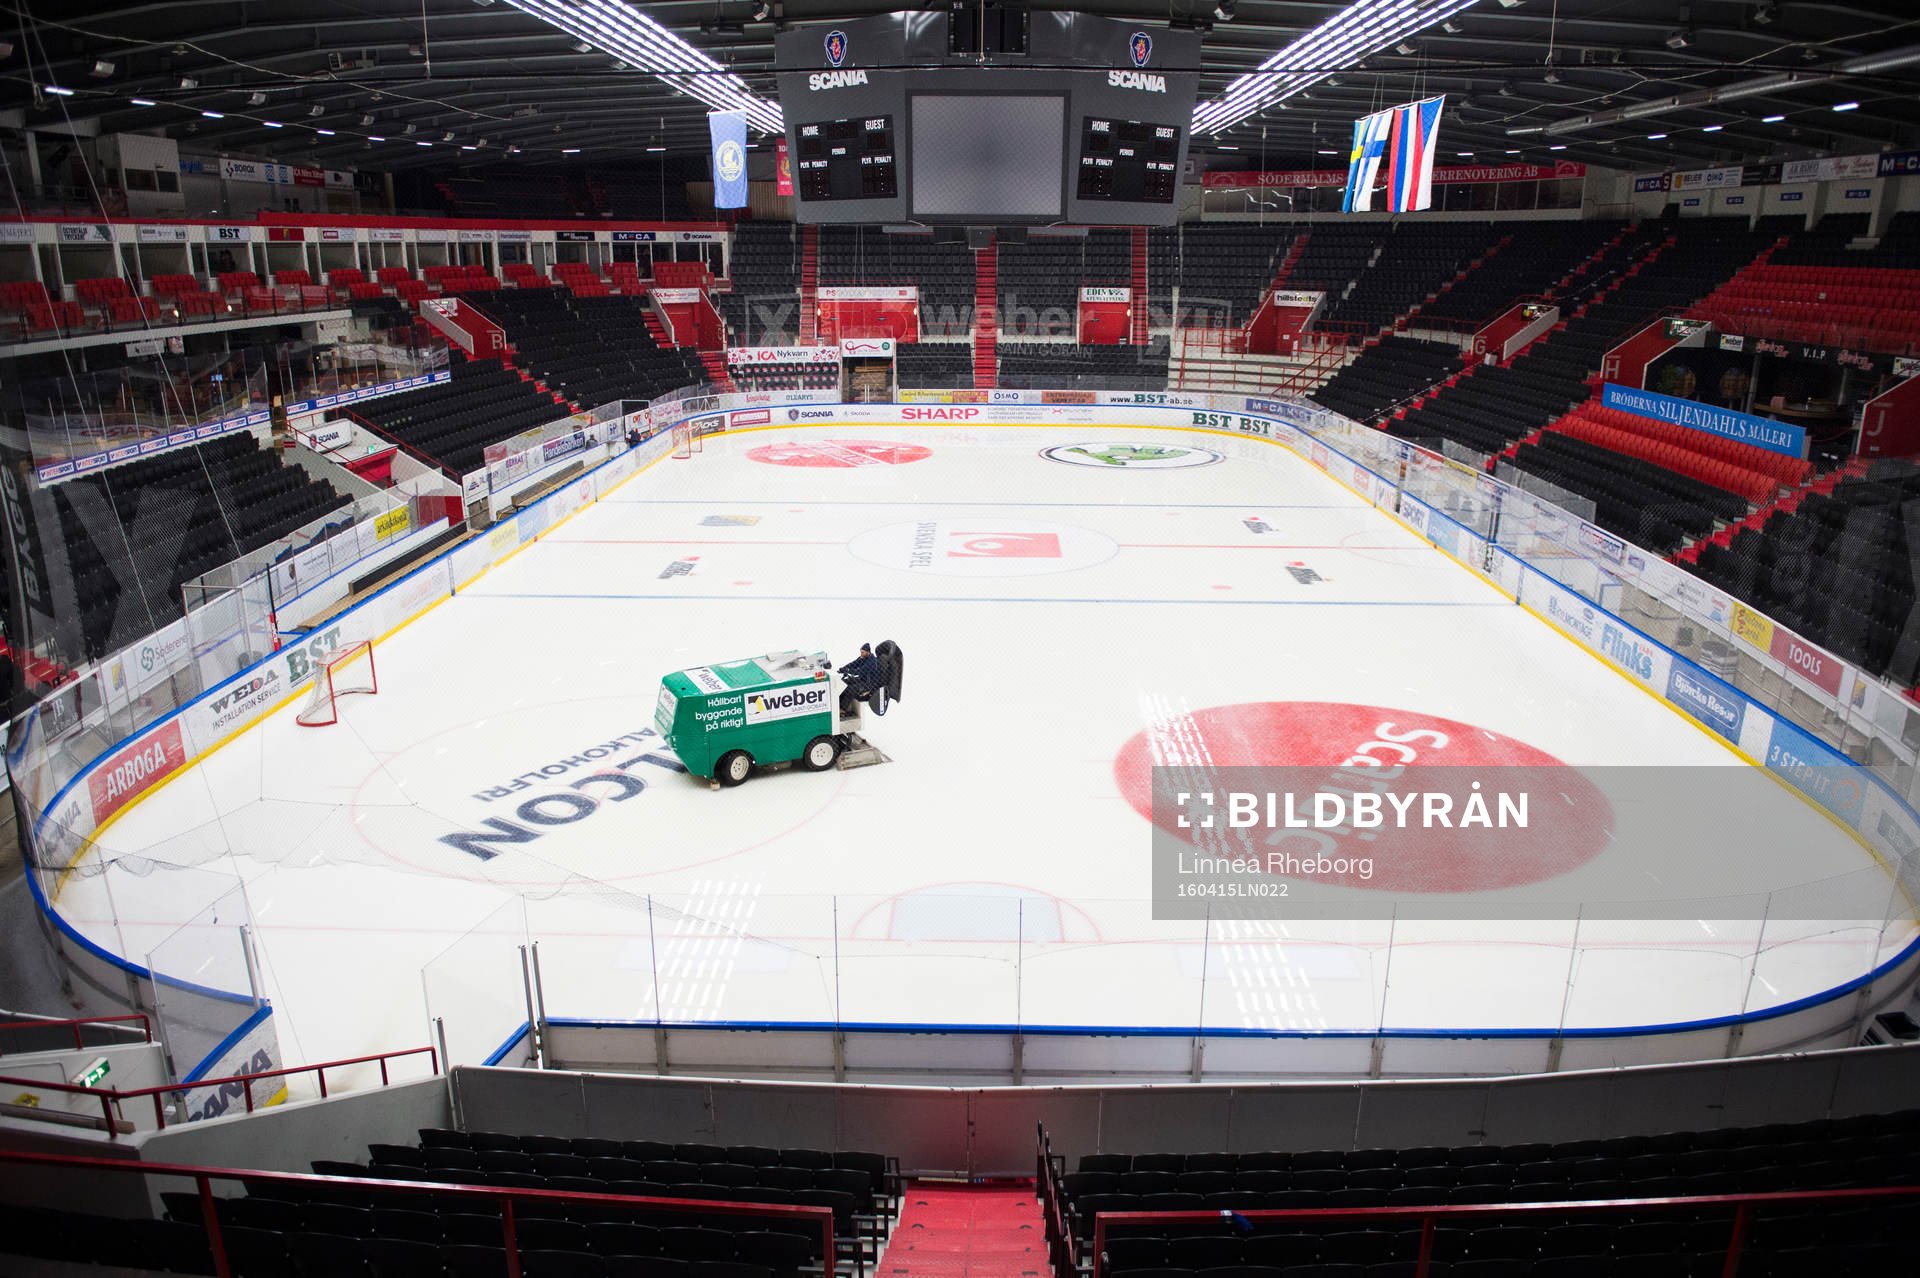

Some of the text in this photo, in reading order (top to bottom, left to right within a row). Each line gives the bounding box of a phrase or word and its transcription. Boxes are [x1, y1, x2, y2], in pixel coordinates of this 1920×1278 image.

[809, 70, 868, 91] SCANIA
[1108, 70, 1166, 93] SCANIA
[802, 126, 819, 136] HOME
[865, 119, 885, 130] GUEST
[1092, 121, 1110, 132] HOME
[1156, 128, 1174, 138] GUEST
[812, 160, 828, 168] PENALTY
[874, 156, 892, 164] PENALTY
[1096, 158, 1113, 166] PENALTY
[1158, 163, 1175, 171] PENALTY
[1881, 156, 1920, 172] MEC
[1257, 173, 1344, 185] SÖDERMALMS
[1432, 167, 1522, 181] ERRENOVERING
[1524, 166, 1538, 177] AB
[219, 228, 240, 239] BST
[491, 333, 503, 350] B
[1474, 339, 1486, 355] G
[757, 350, 808, 361] ICA Nykvarn
[1605, 360, 1620, 379] H
[801, 410, 834, 418] SCANIA
[901, 408, 979, 420] SHARP
[1192, 412, 1232, 428] BST
[1610, 391, 1793, 448] BRÖDERNA SILJENDAHLS MÅLERI
[1239, 417, 1271, 435] BST
[1866, 410, 1885, 436] J
[318, 431, 340, 444] SCANIA
[286, 626, 340, 683] BST
[1600, 622, 1653, 680] Flinks
[1788, 644, 1822, 675] TOOLS
[209, 669, 279, 714] WEDA
[764, 689, 826, 710] weber
[212, 682, 281, 731] INSTALLATION SERVICE
[707, 695, 742, 708] Hållbart
[695, 707, 743, 721] byggande
[705, 721, 719, 732] på
[106, 741, 167, 802] ARBOGA
[471, 726, 657, 803] ALKOHOLFRI
[1771, 745, 1831, 795] 3 STEP IT
[438, 748, 690, 862] LCON
[189, 1048, 273, 1121] ANIA
